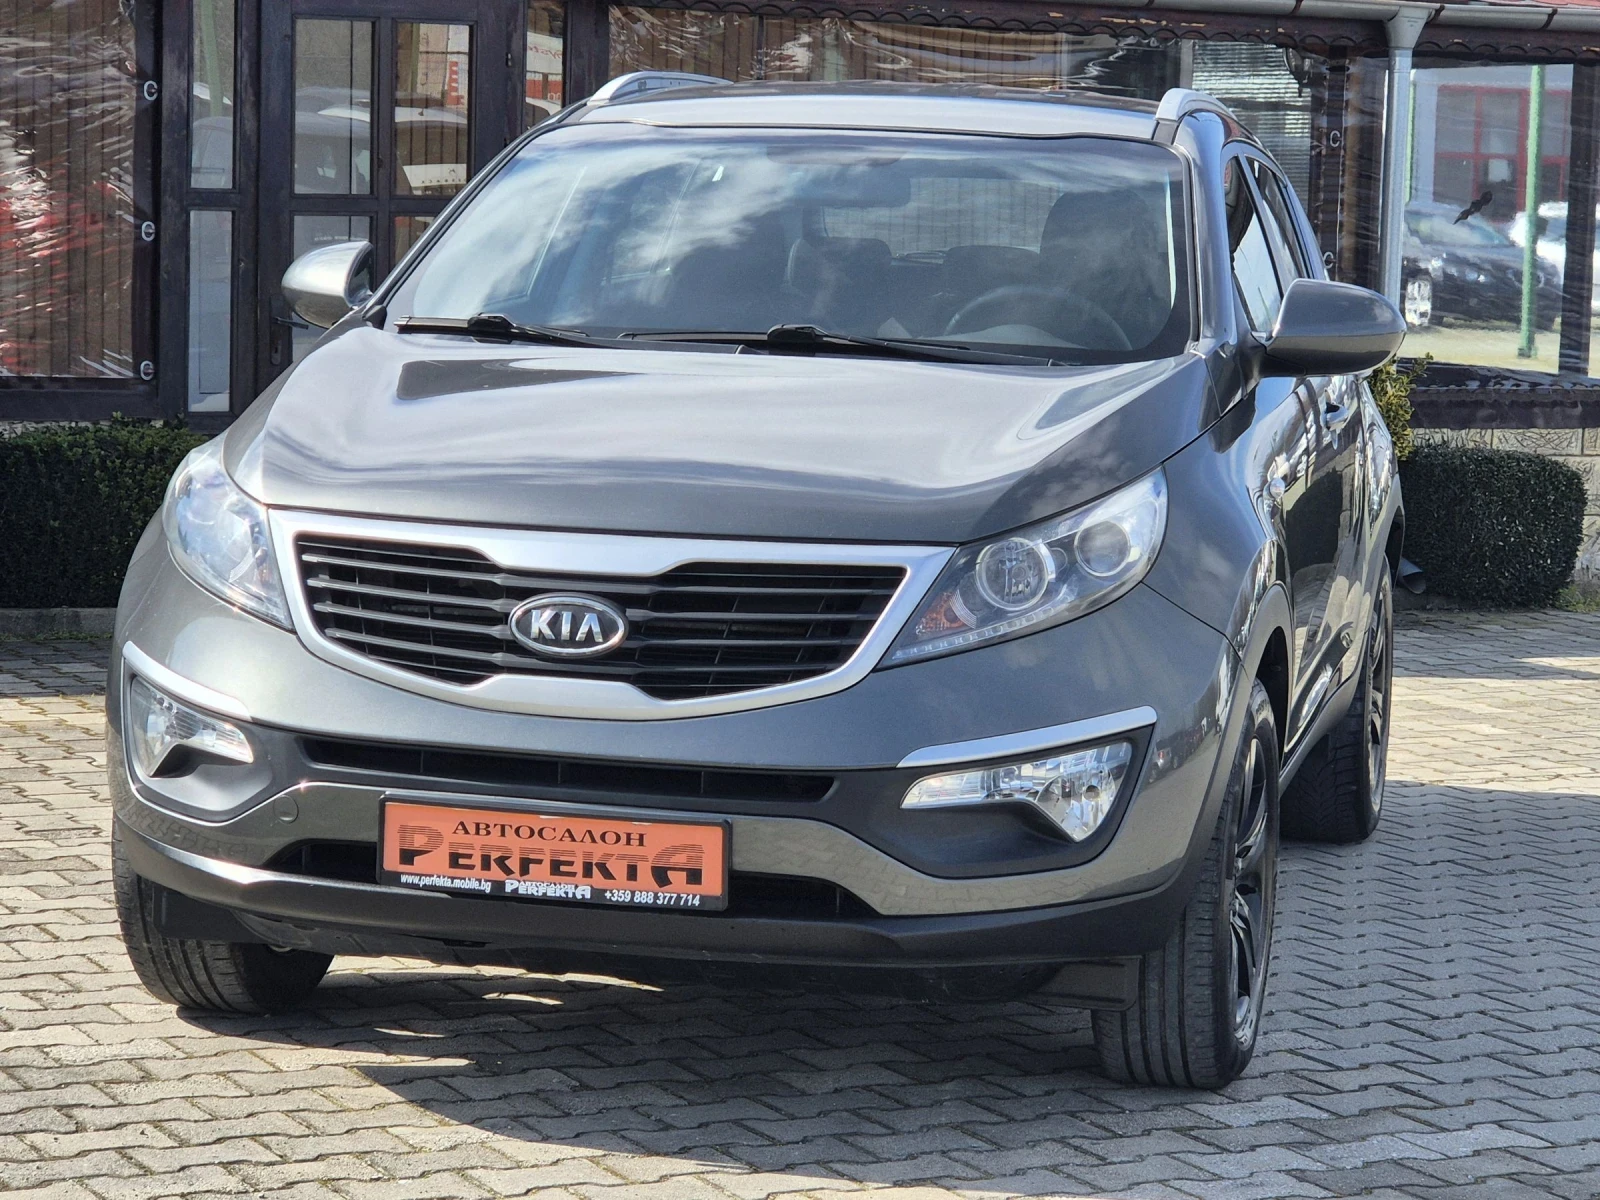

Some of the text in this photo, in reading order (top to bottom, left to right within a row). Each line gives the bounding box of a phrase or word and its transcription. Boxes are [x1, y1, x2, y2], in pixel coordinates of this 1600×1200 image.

[530, 609, 604, 643] KIA
[451, 820, 647, 848] АВТОСАЛОН
[397, 824, 705, 888] PERFEKTA
[400, 873, 492, 894] www.perfekta.mobile.bg
[604, 889, 701, 907] +359 888 377 714
